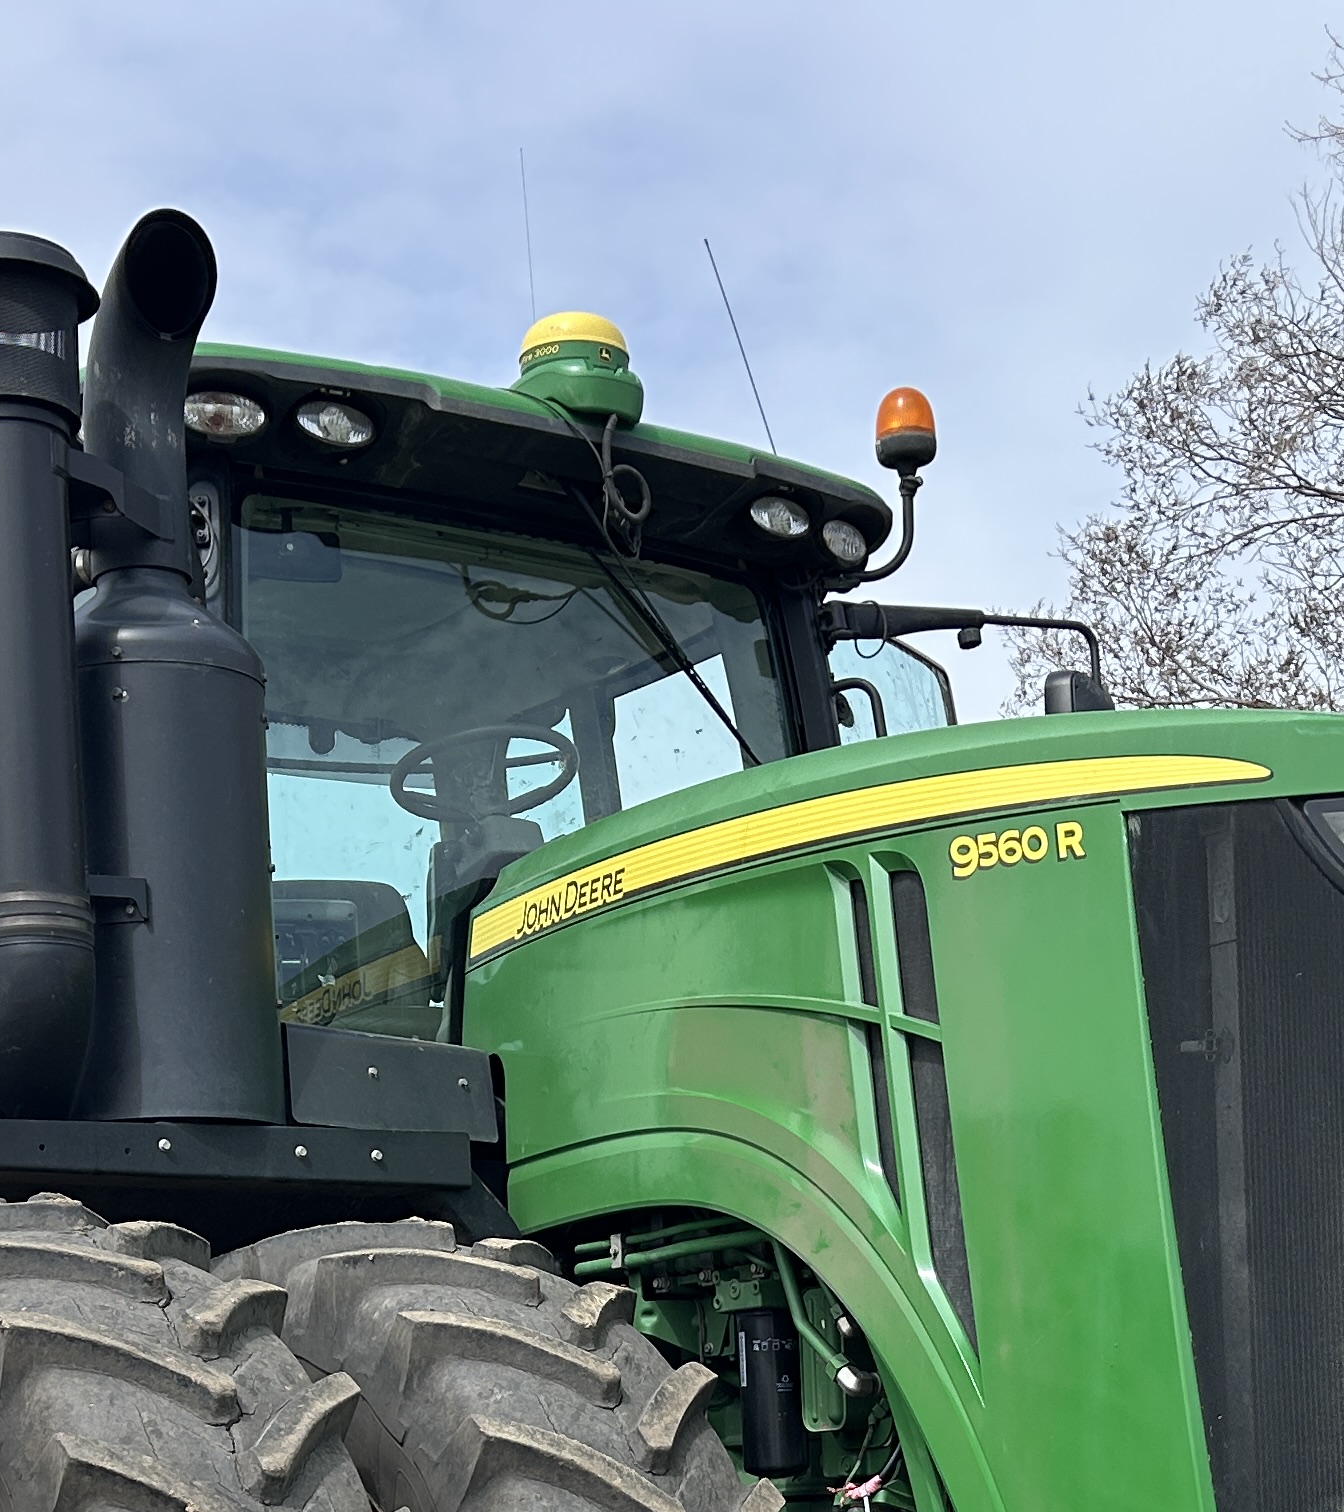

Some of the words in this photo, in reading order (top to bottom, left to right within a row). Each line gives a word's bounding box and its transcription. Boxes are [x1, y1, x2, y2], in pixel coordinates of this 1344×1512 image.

[534, 344, 560, 358] 3000
[949, 825, 1049, 880] 9560
[1055, 820, 1087, 862] R
[516, 891, 562, 935] JOHN
[564, 867, 626, 914] DEERE
